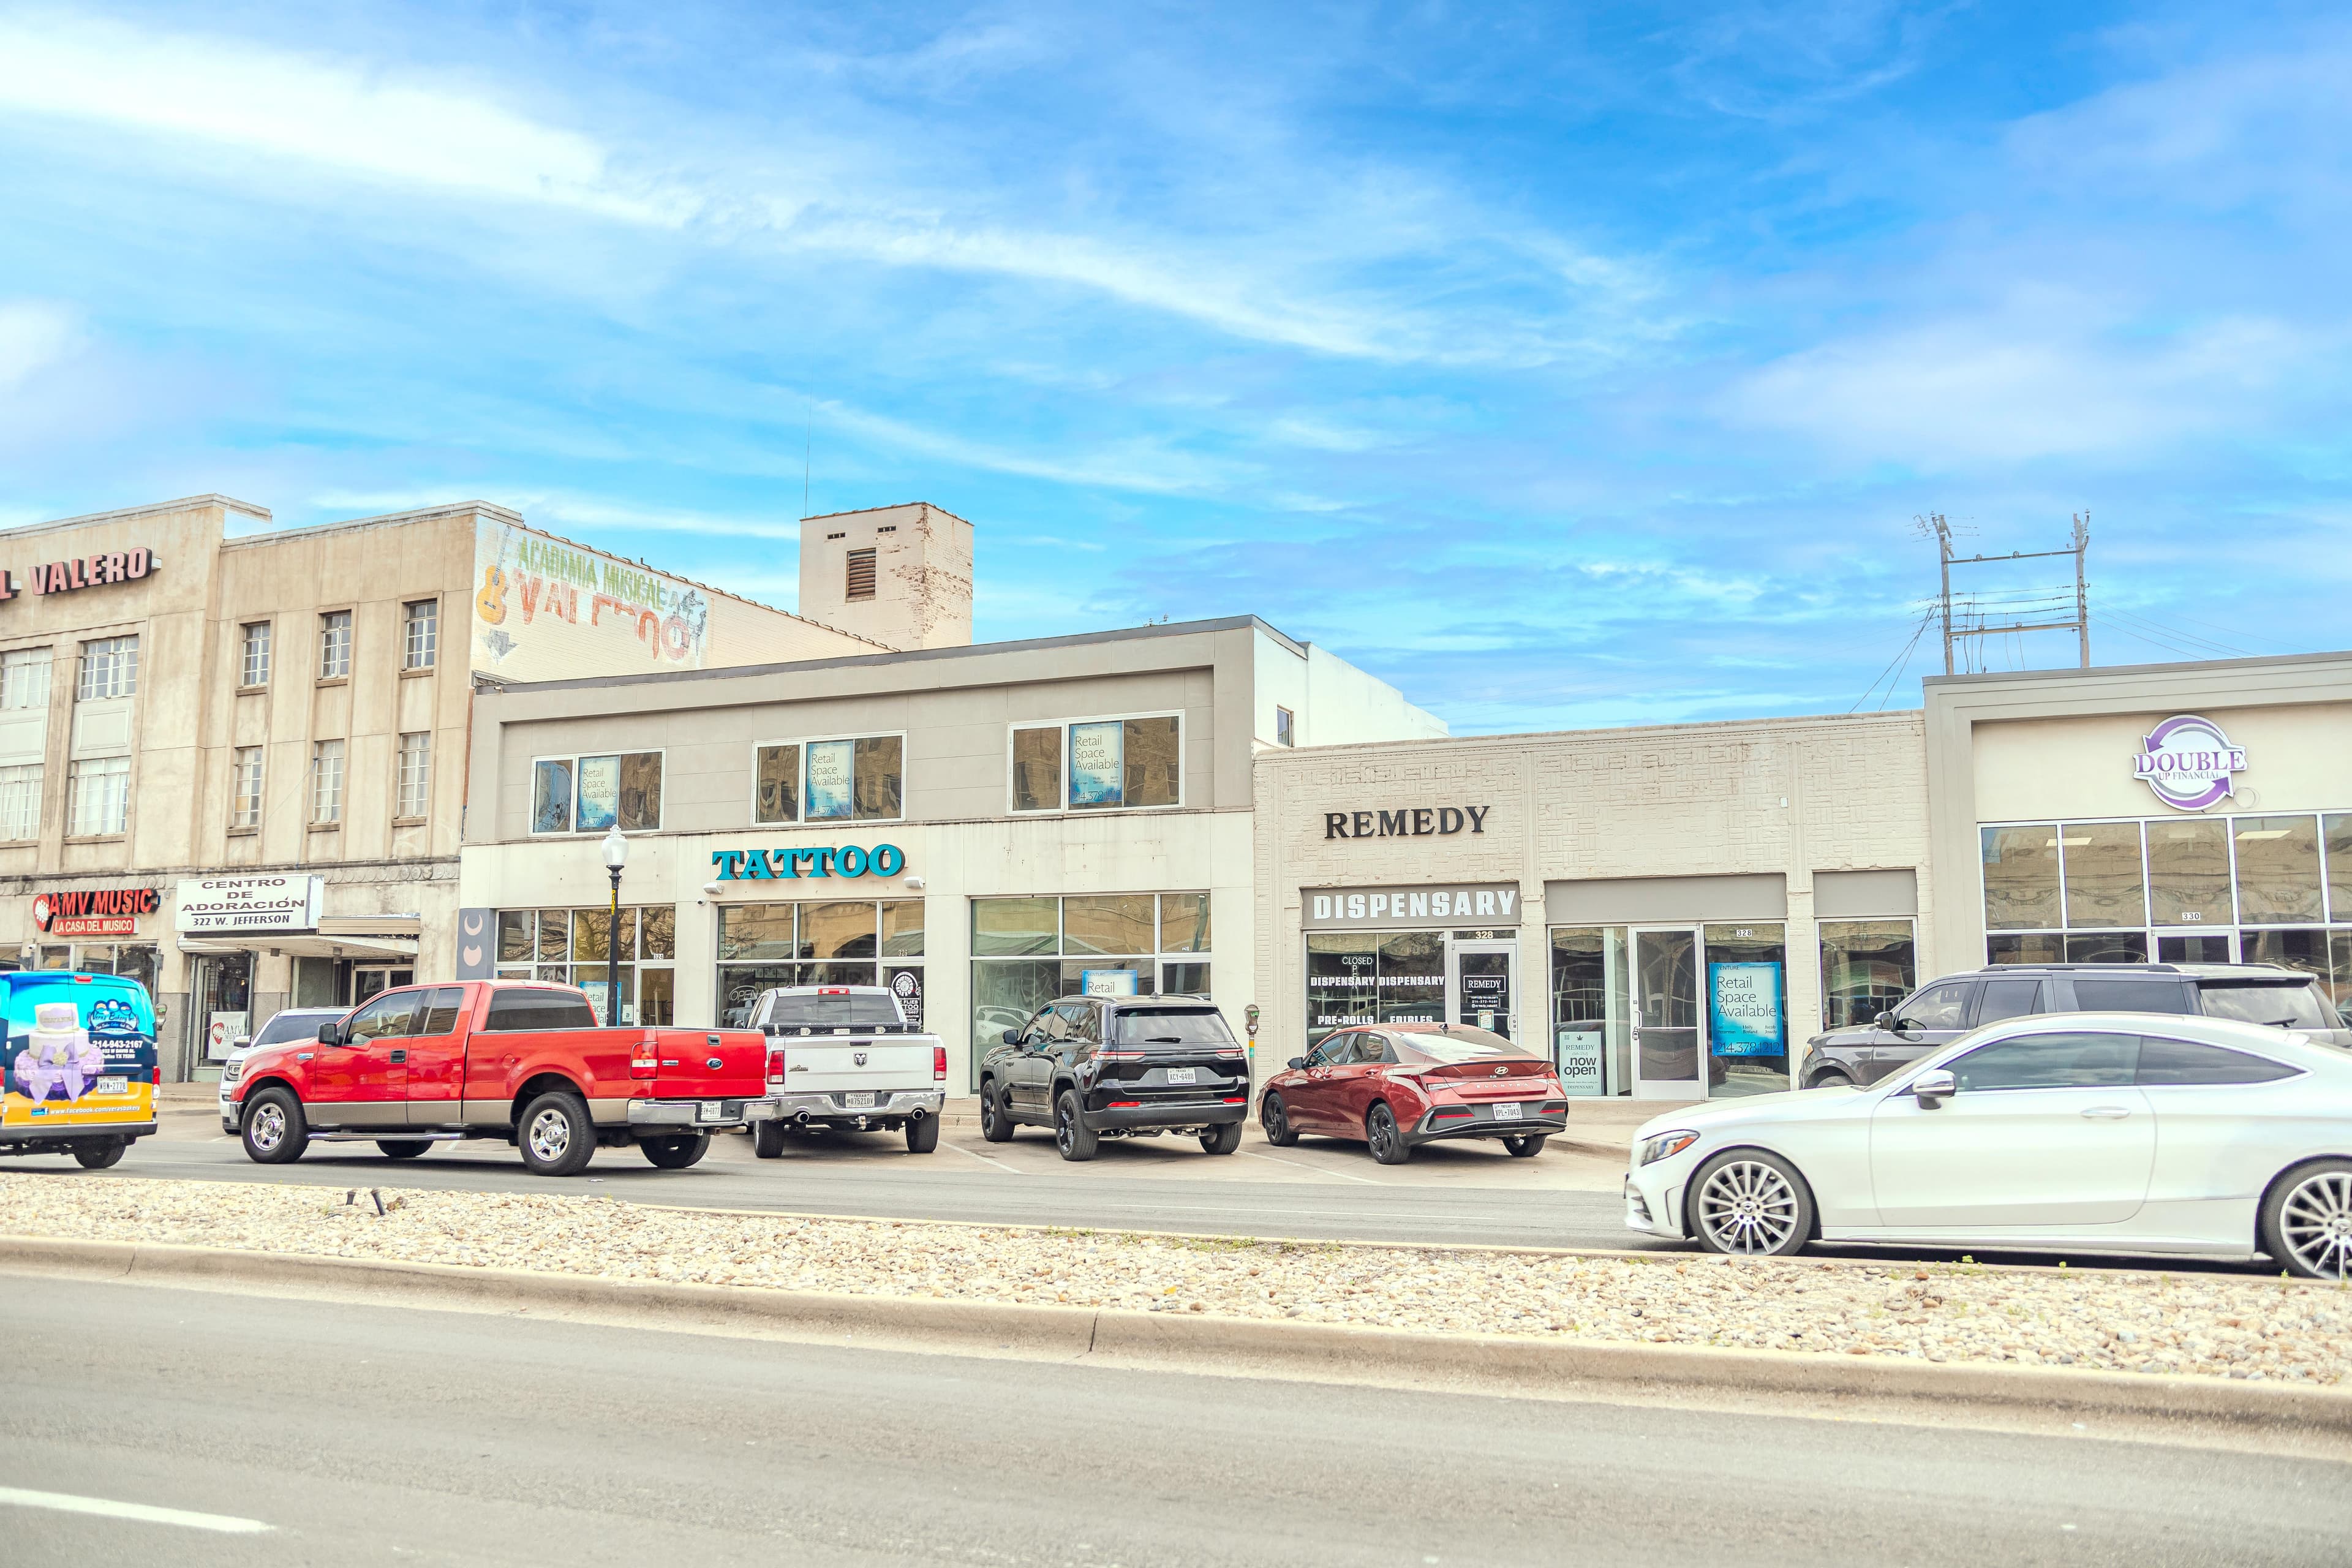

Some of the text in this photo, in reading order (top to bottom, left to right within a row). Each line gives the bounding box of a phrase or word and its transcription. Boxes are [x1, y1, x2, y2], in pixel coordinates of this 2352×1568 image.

[28, 546, 152, 596] VALERO
[518, 537, 598, 590] ACADEMIA
[603, 563, 664, 611] MUSICAL
[1075, 734, 1102, 747] Retail
[812, 752, 835, 764] Retail
[1075, 748, 1105, 761] Space
[1074, 758, 1119, 771] Available
[2137, 751, 2245, 772] DOUBLE
[583, 767, 604, 778] Retail
[811, 765, 837, 777] Space
[2173, 771, 2221, 780] FINANCIAL
[582, 779, 606, 790] Space
[811, 775, 850, 786] Available
[582, 788, 617, 799] Available
[1072, 790, 1121, 801] 214.378.1212
[1324, 805, 1490, 839] REMEDY
[712, 844, 905, 880] TATTOO
[202, 878, 285, 889] CENTRO
[48, 889, 153, 916] AMV MUSIC
[181, 896, 305, 911] ADORACIÓN
[1314, 890, 1515, 919] DISPENSARY
[55, 919, 132, 932] LA CASA DEL MUSICO
[214, 917, 228, 925] W.
[233, 915, 290, 925] JEFFERSON
[1088, 981, 1115, 993] Retail
[1311, 976, 1375, 986] DISPENSARY
[1379, 976, 1445, 986] DISPENSARY
[1717, 976, 1752, 989] Retail
[731, 989, 758, 1001] OPEN
[1717, 990, 1757, 1006] Space
[1717, 1004, 1776, 1017] Available
[1318, 1016, 1374, 1025] PRE-ROLLS
[224, 1025, 243, 1034] AMV
[1716, 1042, 1779, 1053] 214.378.1212
[1570, 1057, 1597, 1066] now
[1564, 1066, 1596, 1078] open
